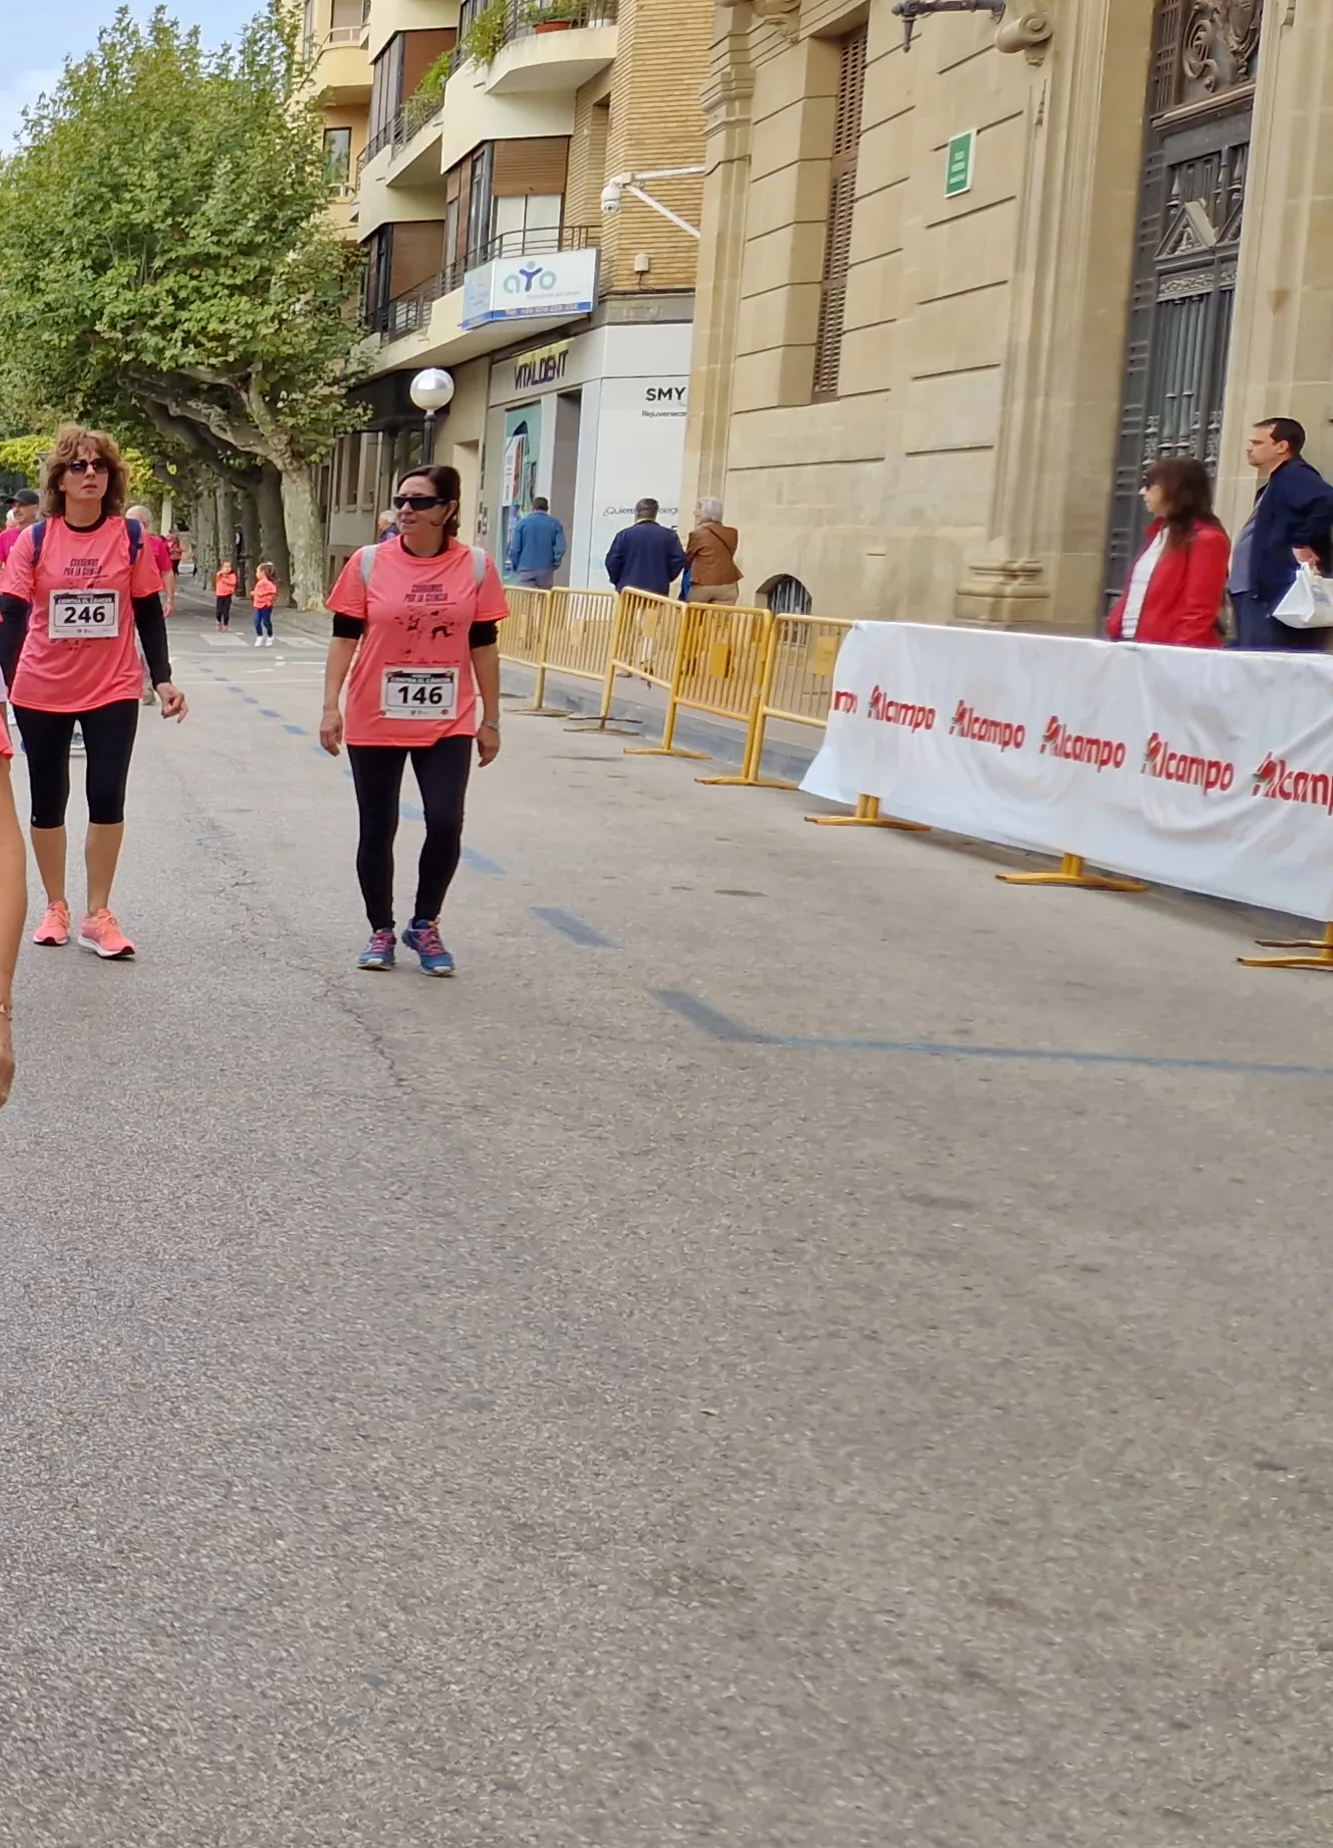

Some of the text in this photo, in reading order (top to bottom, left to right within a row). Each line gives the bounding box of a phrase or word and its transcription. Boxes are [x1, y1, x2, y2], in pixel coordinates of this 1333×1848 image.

[64, 606, 105, 624] 246
[398, 685, 443, 704] 146
[868, 685, 936, 733] Alcampo
[949, 699, 1026, 752] Alcampo
[1039, 715, 1127, 773] Alcampo
[1140, 732, 1235, 796] Alcampo
